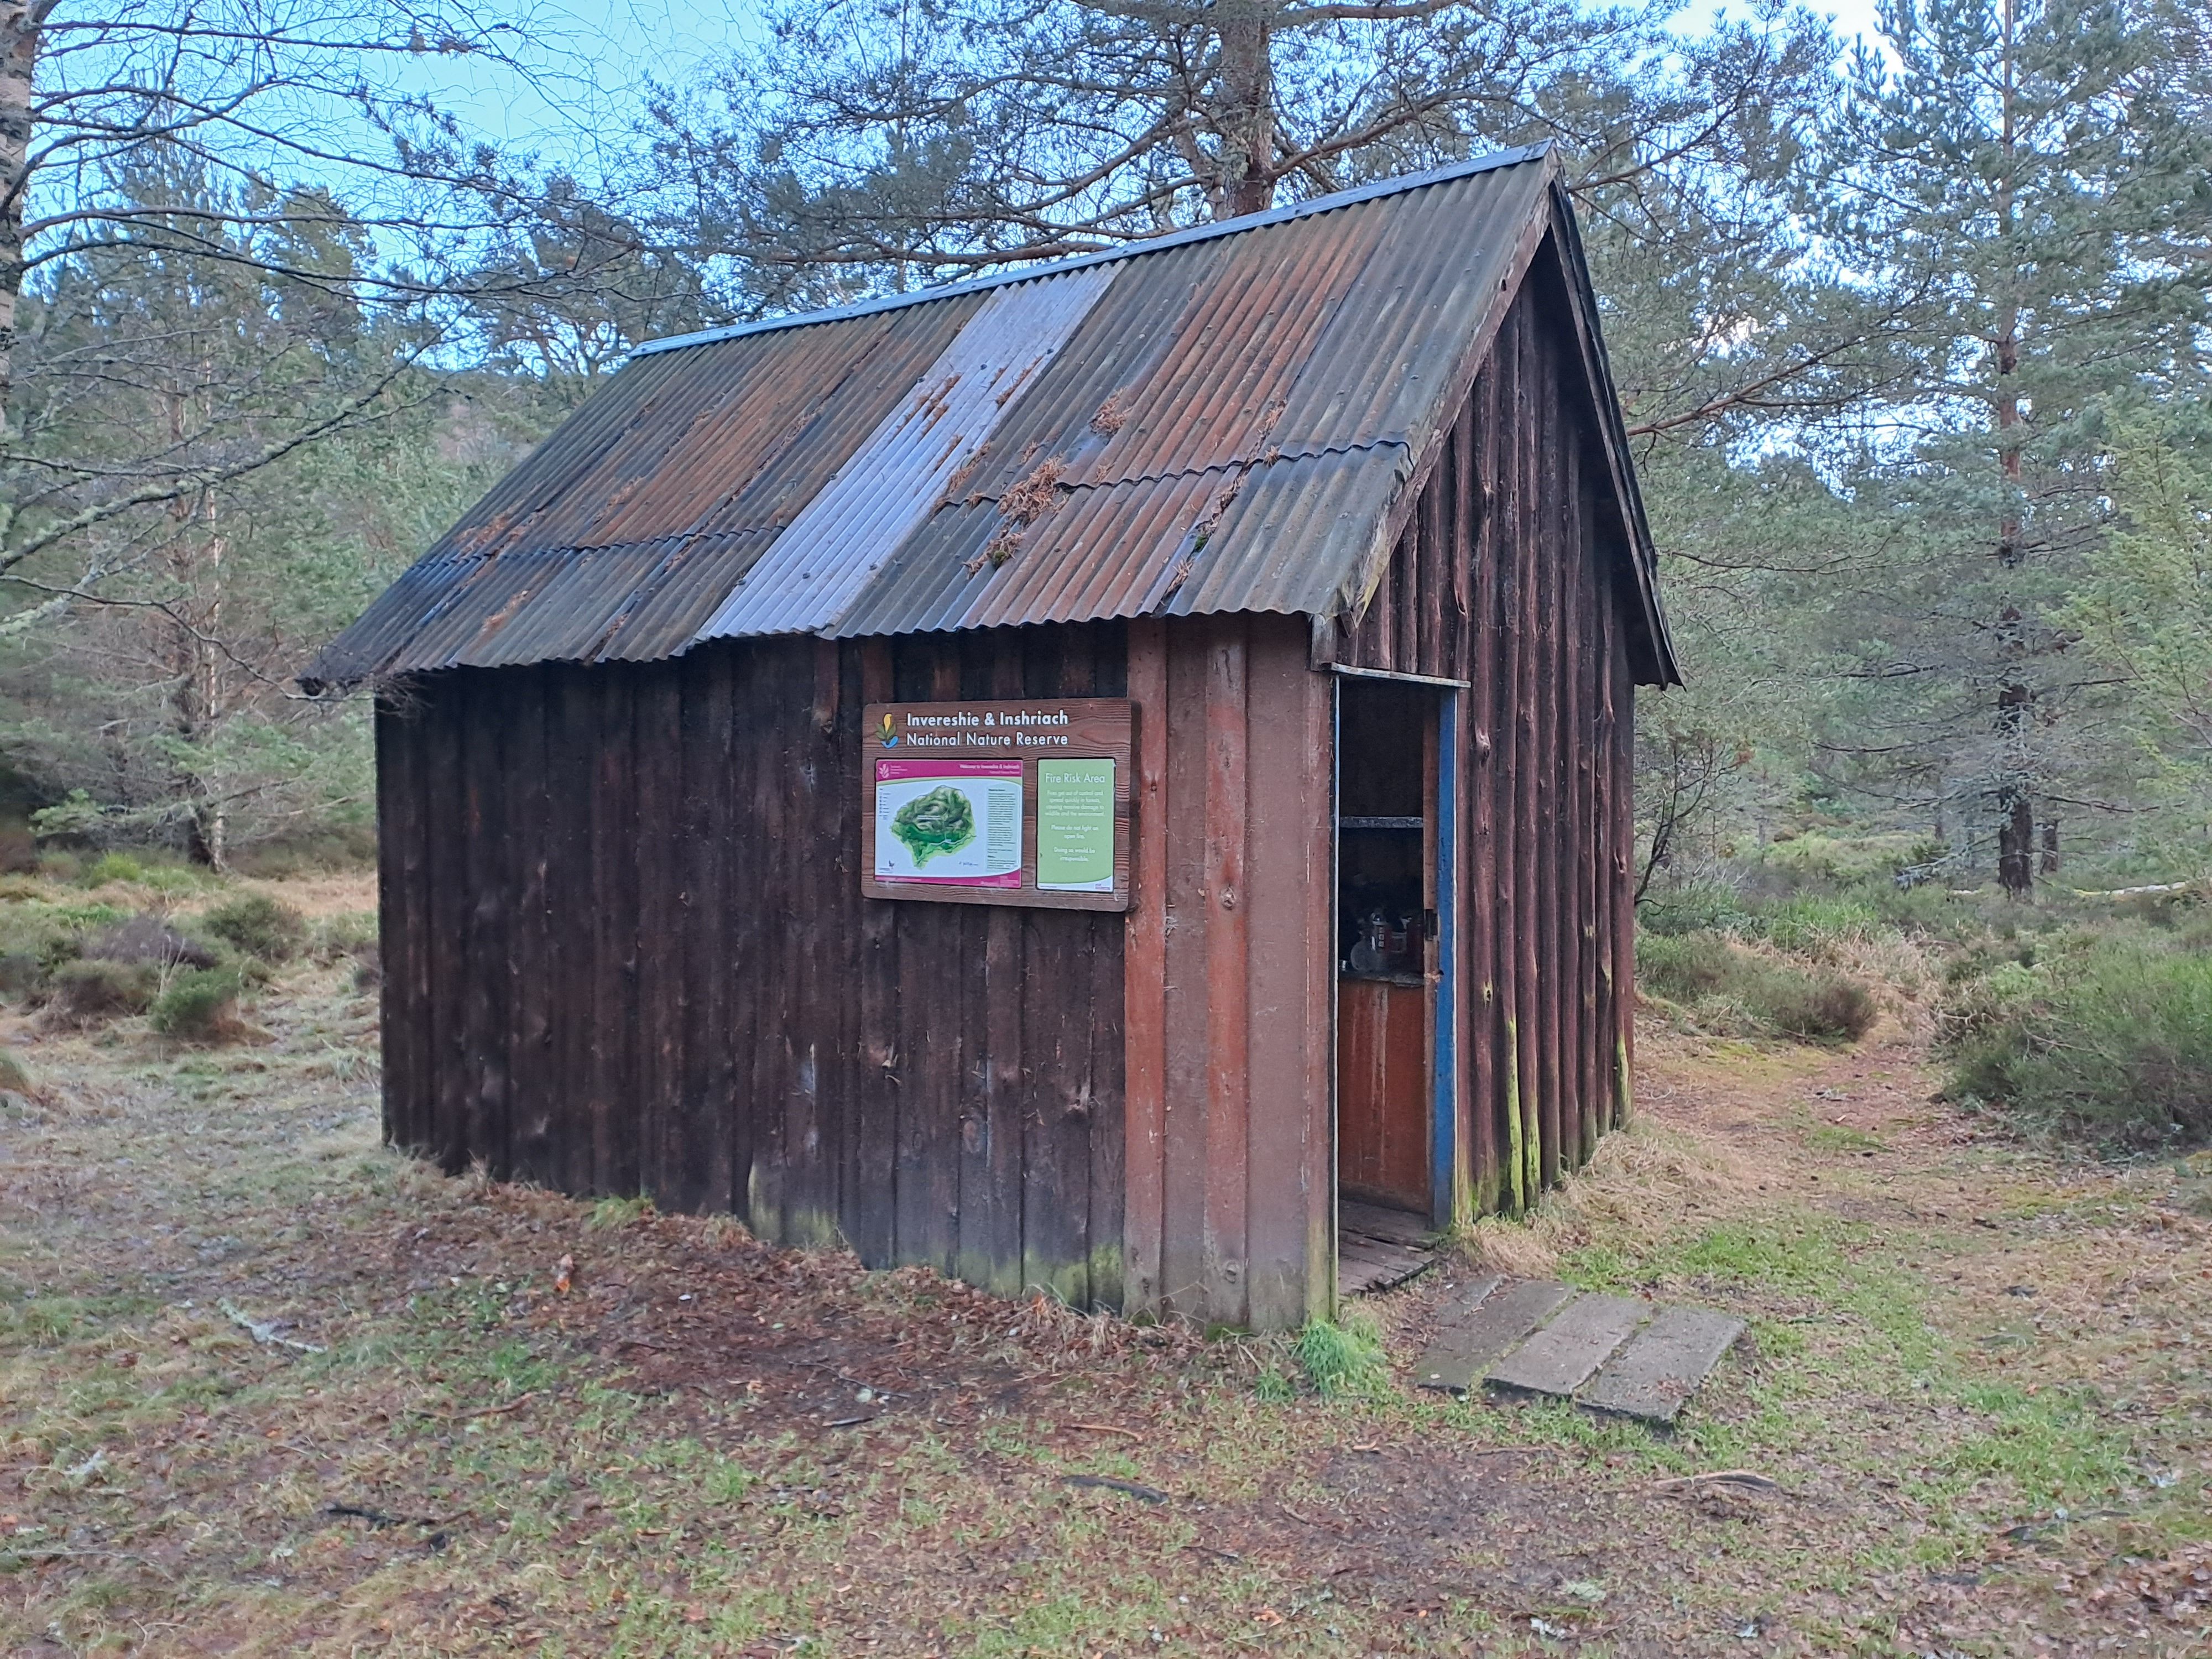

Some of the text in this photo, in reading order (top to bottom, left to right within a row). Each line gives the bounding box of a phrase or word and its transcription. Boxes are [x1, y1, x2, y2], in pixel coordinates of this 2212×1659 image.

[907, 709, 1068, 727] Invereshie & Inshriach
[906, 731, 1068, 745] National Nature Reserve
[1045, 772, 1105, 783] Fire Risk Area
